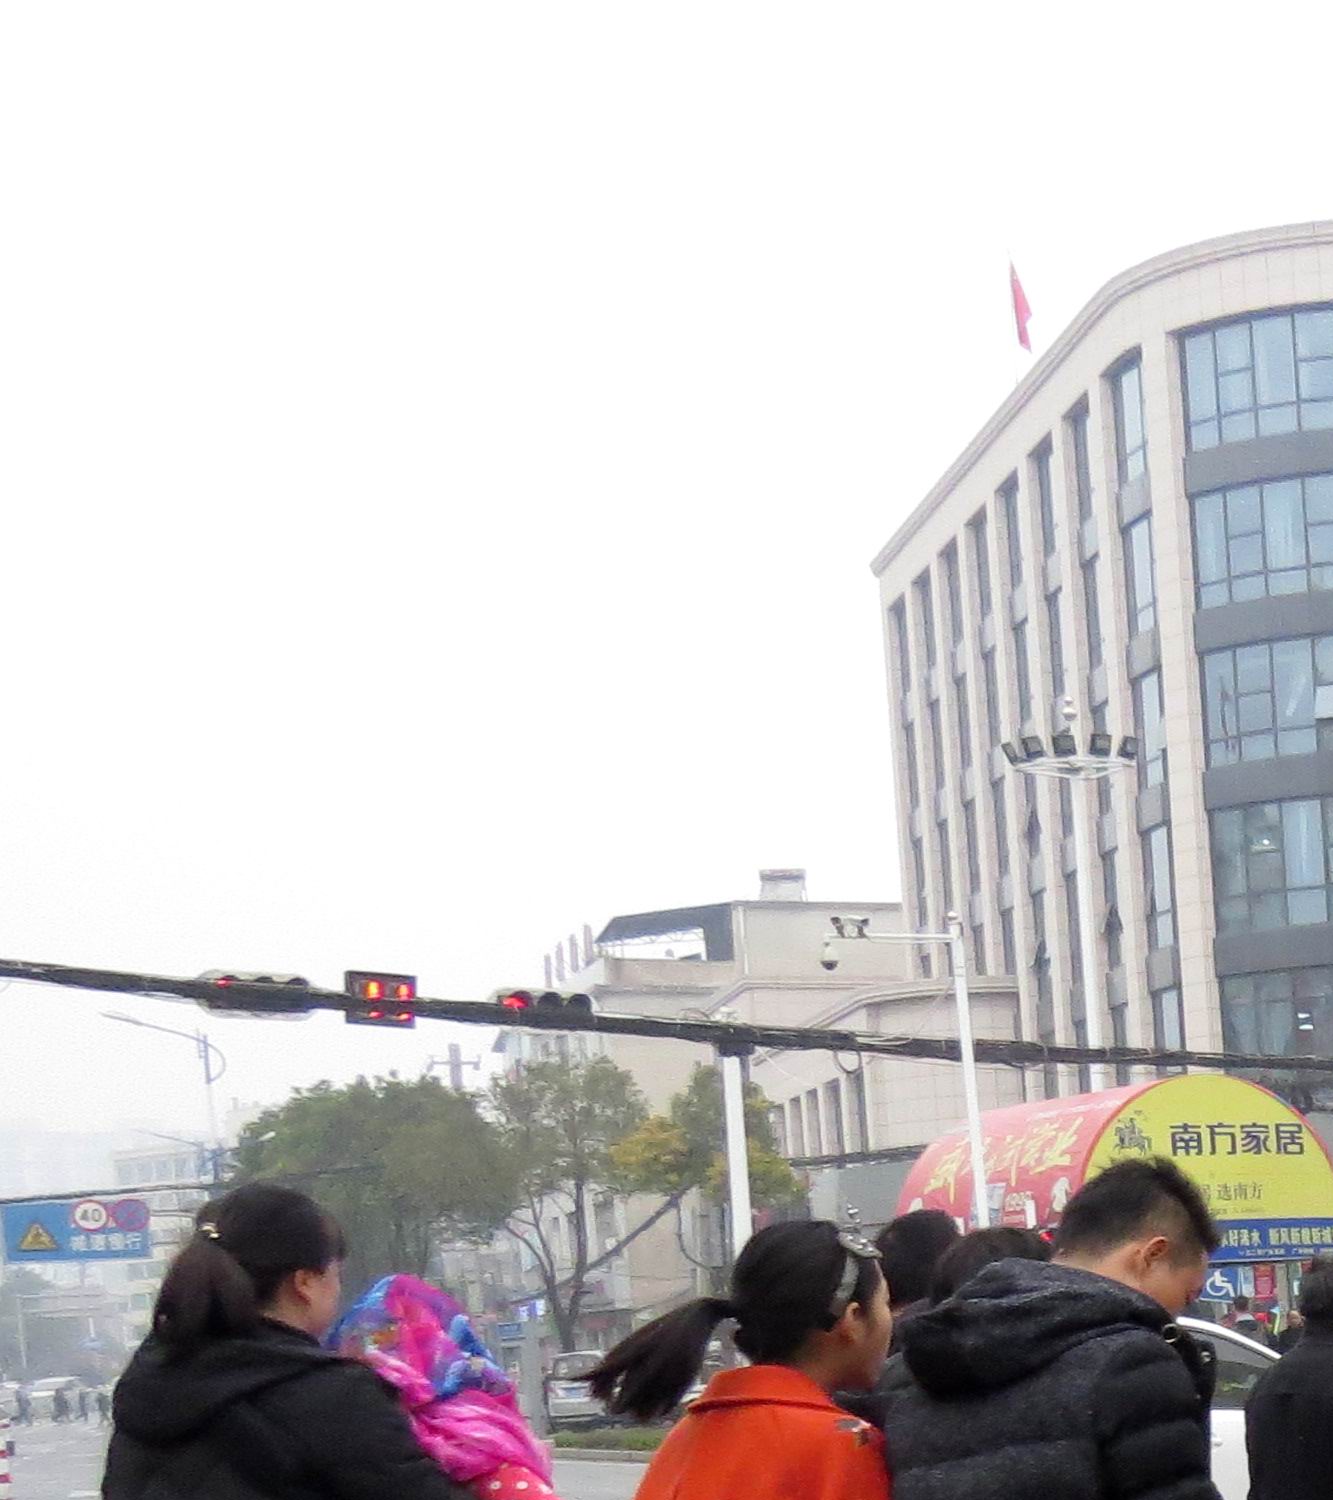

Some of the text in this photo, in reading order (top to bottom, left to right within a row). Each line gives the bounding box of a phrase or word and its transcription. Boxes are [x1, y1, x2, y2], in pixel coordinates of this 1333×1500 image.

[1169, 1122, 1305, 1157] 南方家居
[79, 1208, 103, 1223] 40
